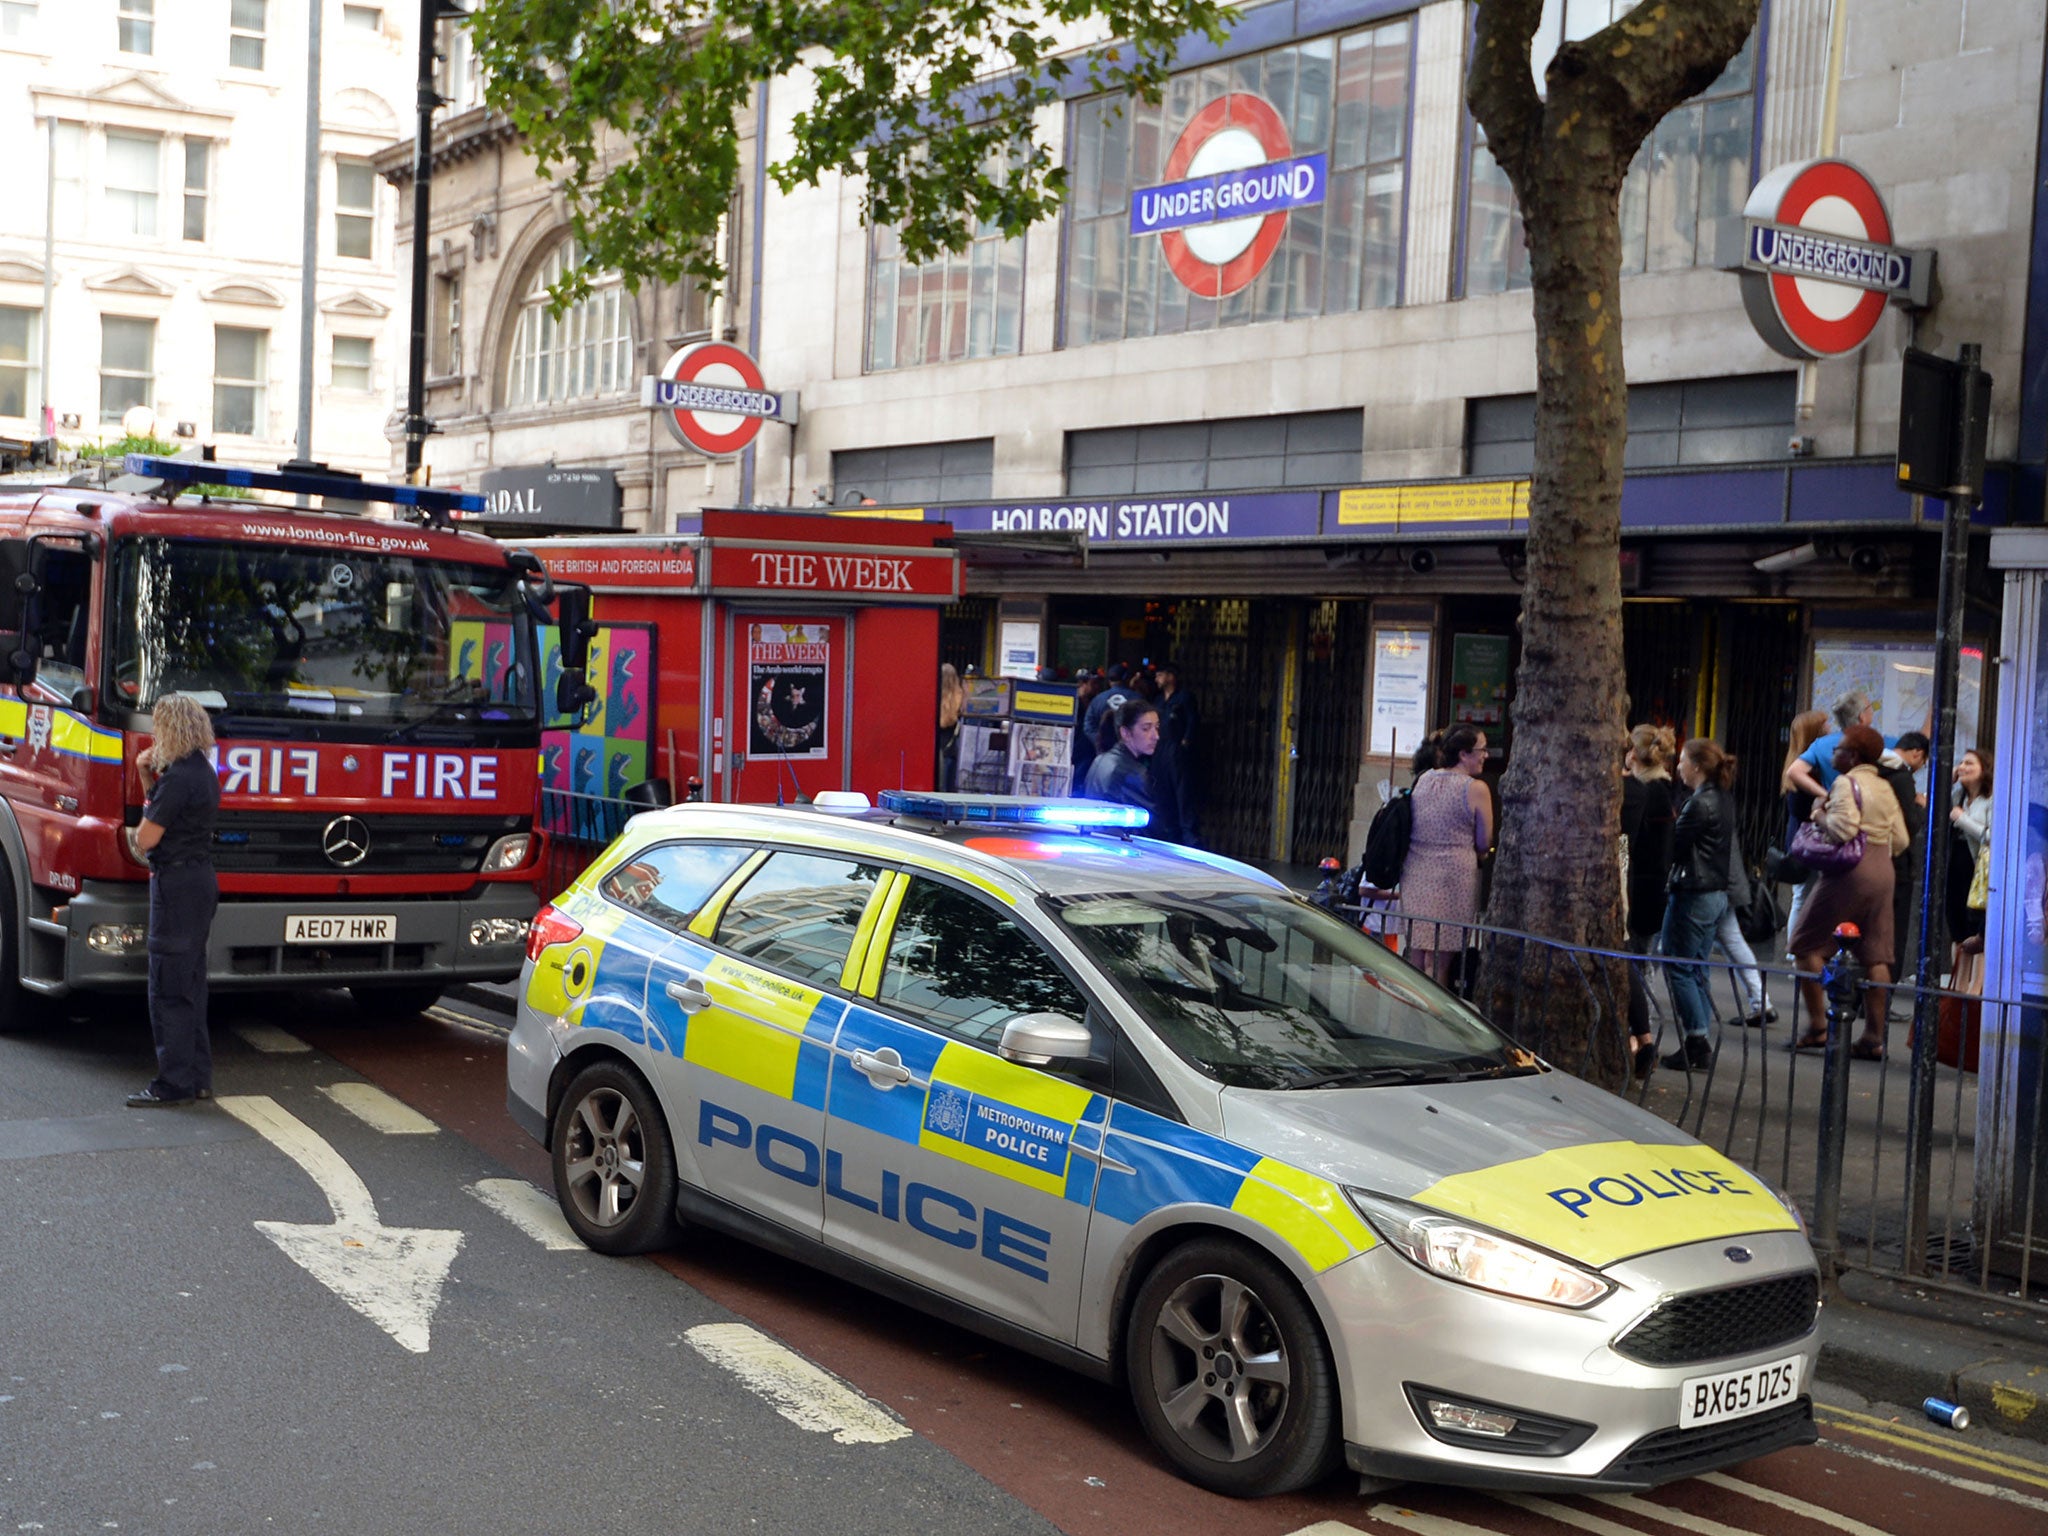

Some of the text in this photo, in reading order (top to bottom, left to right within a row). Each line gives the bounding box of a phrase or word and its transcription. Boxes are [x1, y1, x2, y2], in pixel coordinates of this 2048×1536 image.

[1141, 164, 1315, 226] UNDERGROUND
[1756, 226, 1905, 288] UNDERGROUND
[660, 382, 777, 415] UNDERGROUND
[242, 523, 430, 552] www.london-fire.gov.uk
[1117, 501, 1230, 537] STATION
[550, 559, 565, 573] THE
[566, 559, 599, 573] BRITISH
[601, 559, 620, 573] AND
[621, 559, 660, 574] FOREIGN
[662, 560, 693, 574] MEDIA
[751, 552, 914, 591] THE WEEK
[752, 643, 827, 660] THE WEEK
[382, 751, 498, 799] FIRE
[295, 920, 388, 939] AE07 HWR
[977, 1104, 1065, 1144] METROPOLITAN
[985, 1128, 1049, 1162] POLICE
[698, 1099, 1051, 1284] POLICE
[1546, 1167, 1752, 1218] POLICE
[1693, 1363, 1793, 1419] BX65 DZS
